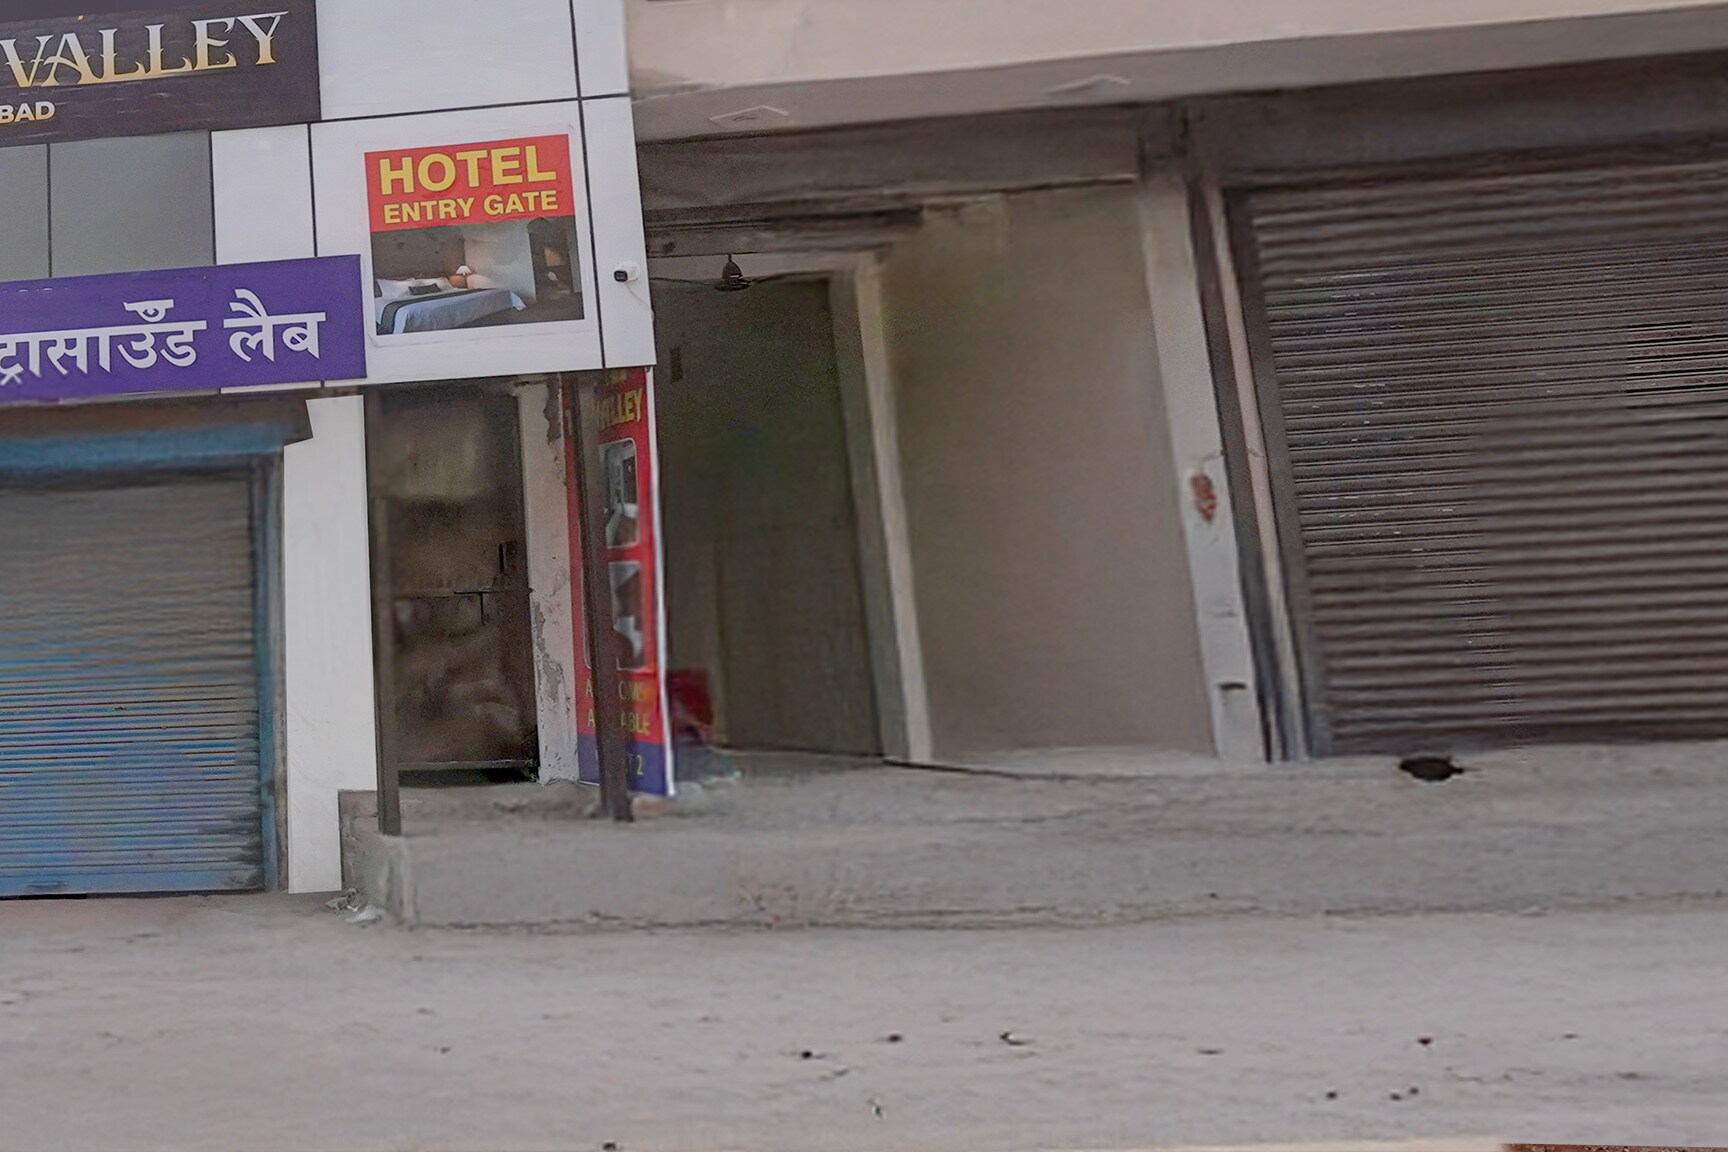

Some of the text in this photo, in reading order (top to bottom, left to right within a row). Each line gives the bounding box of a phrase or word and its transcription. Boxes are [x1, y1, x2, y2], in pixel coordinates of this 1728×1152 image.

[379, 145, 557, 195] HOTEL
[383, 190, 559, 224] ENTRY GATE
[223, 288, 327, 361] लैब
